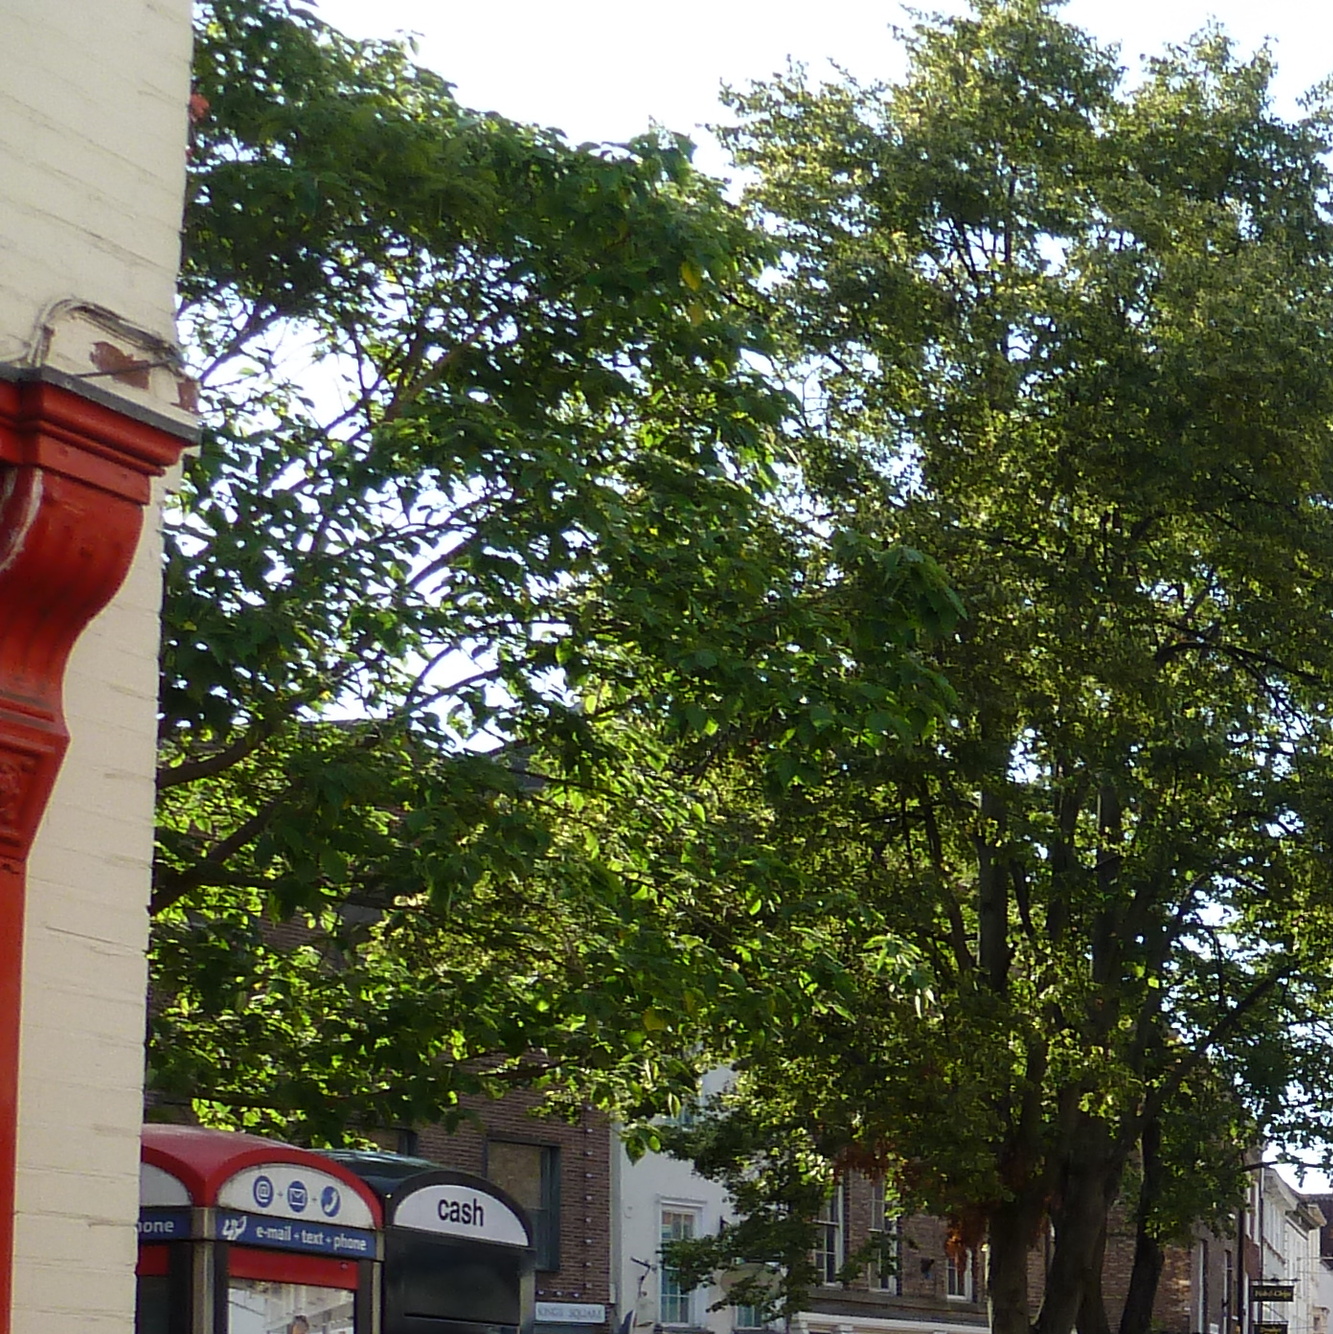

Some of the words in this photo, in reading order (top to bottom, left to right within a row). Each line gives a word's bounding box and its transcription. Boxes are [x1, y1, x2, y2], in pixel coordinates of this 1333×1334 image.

[437, 1197, 484, 1227] cash
[256, 1226, 291, 1241] e-mail
[301, 1231, 324, 1245] text
[333, 1233, 366, 1251] phone
